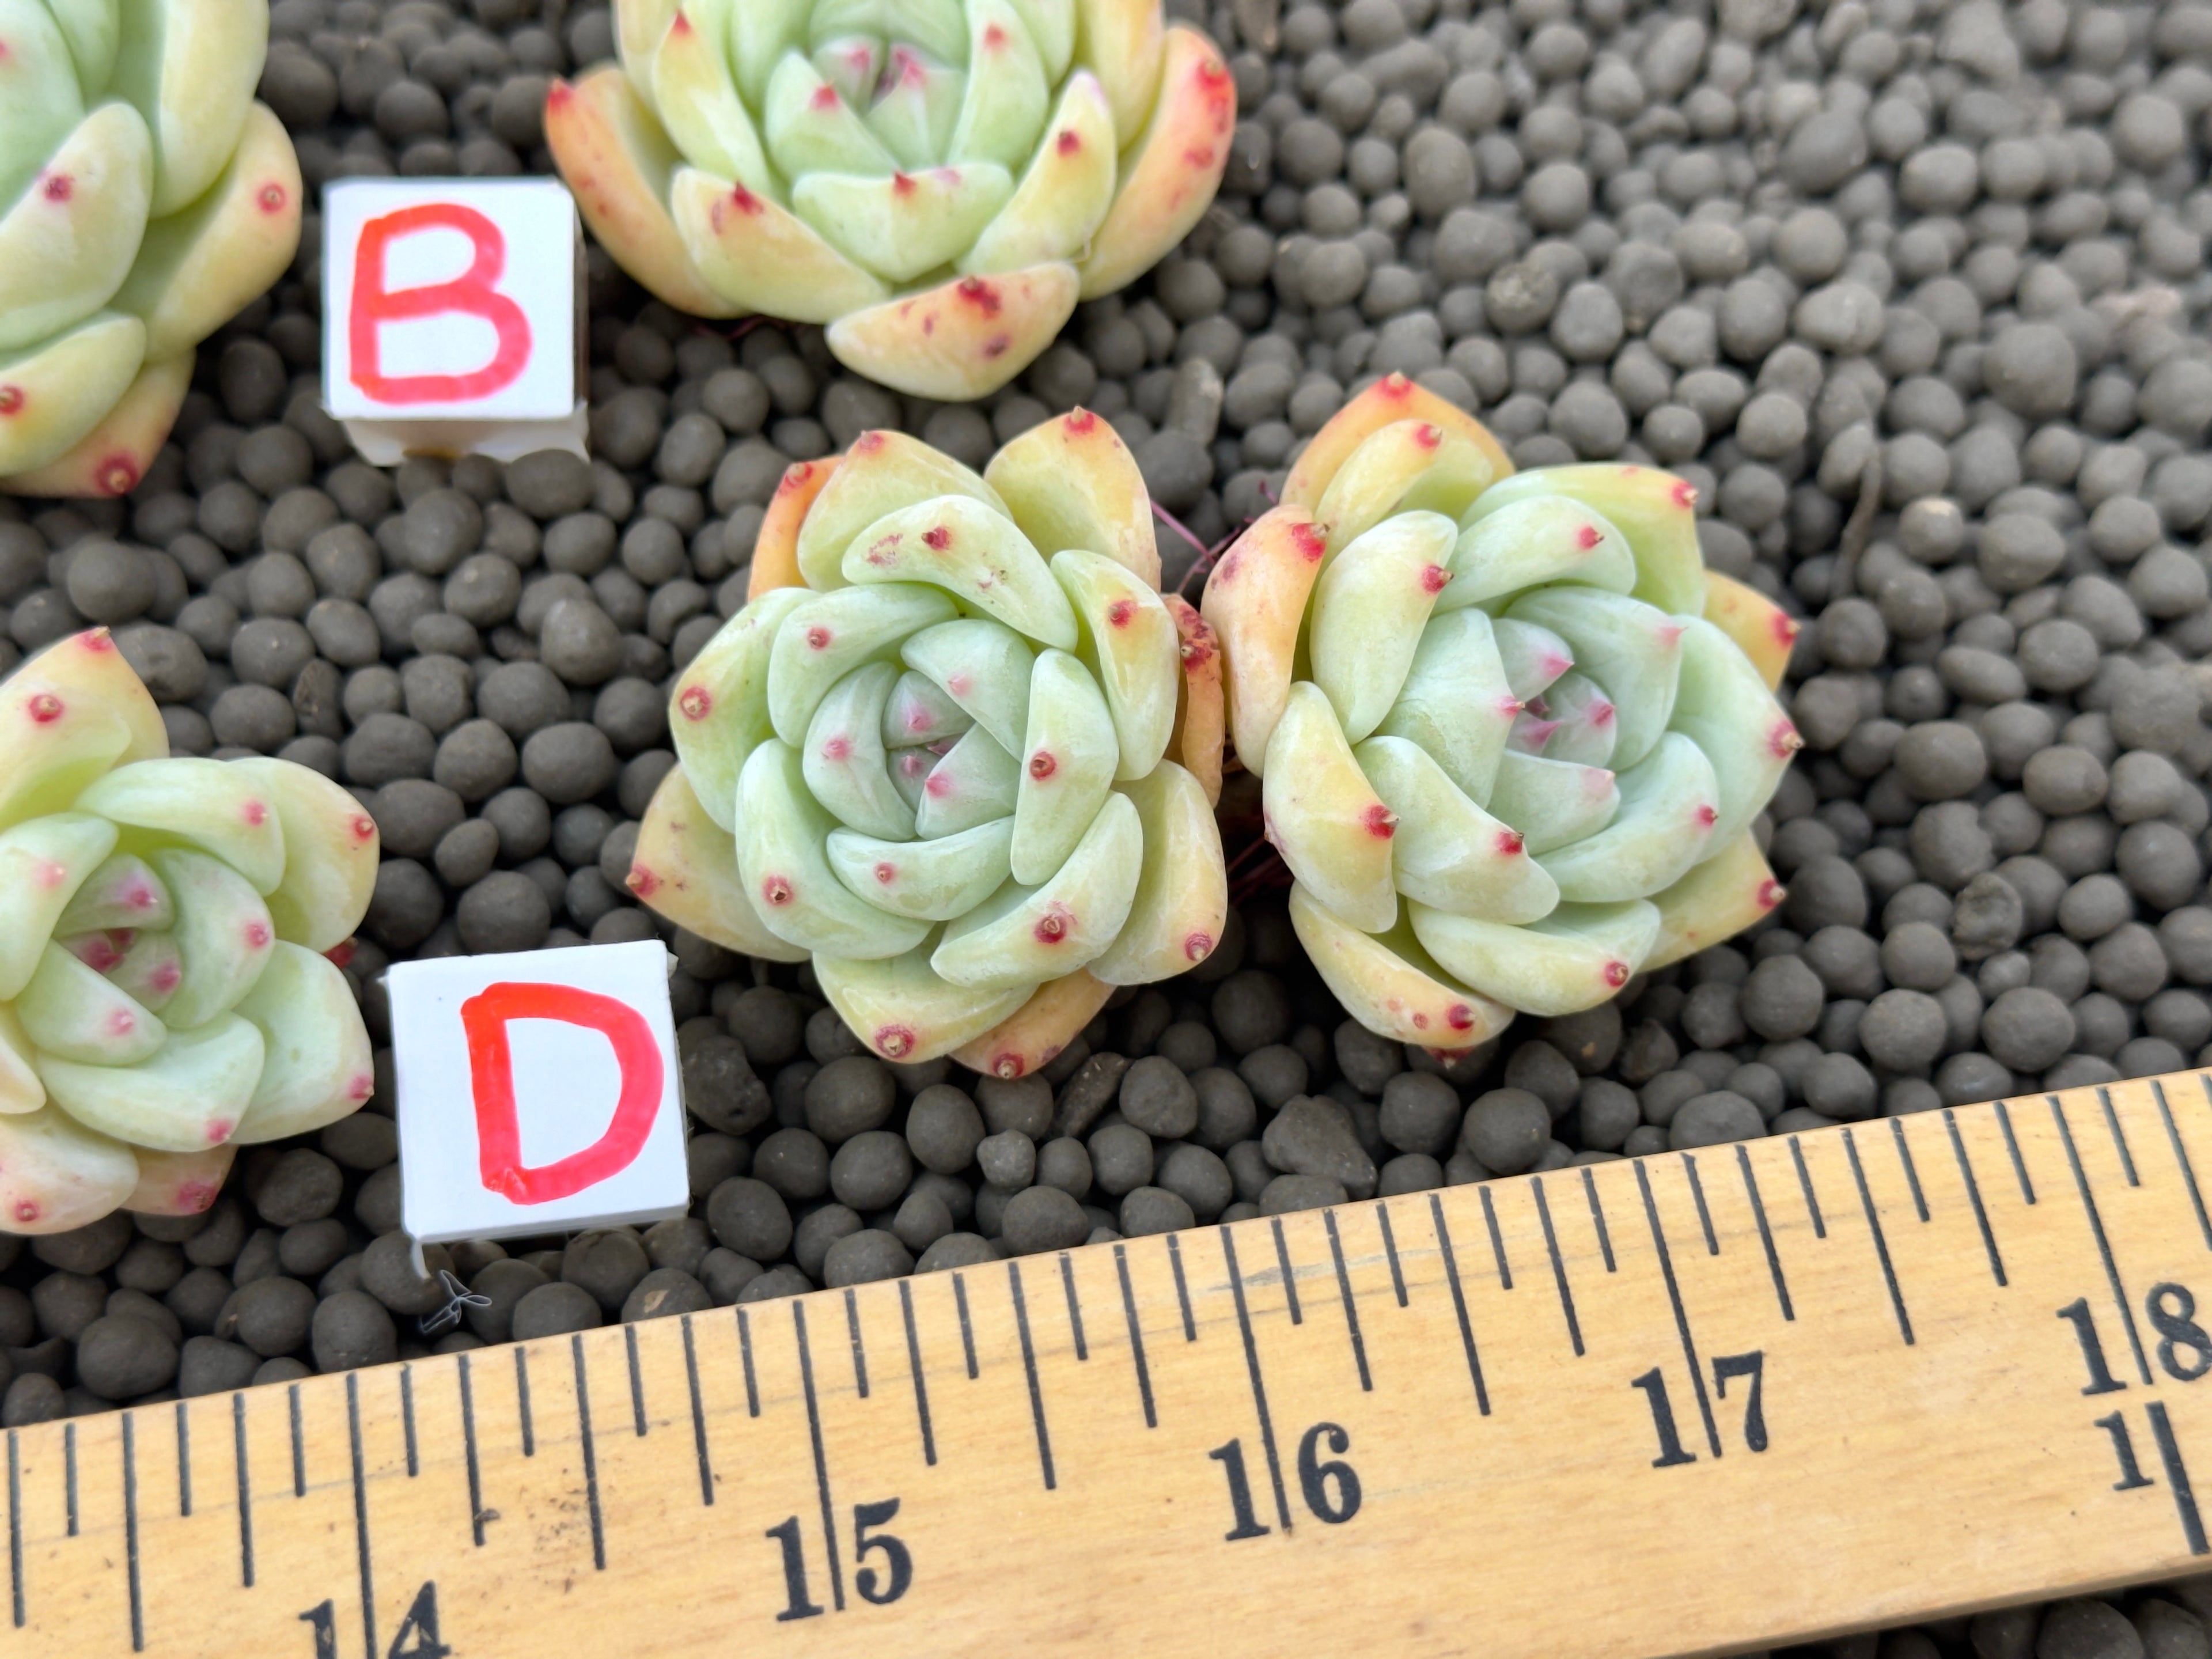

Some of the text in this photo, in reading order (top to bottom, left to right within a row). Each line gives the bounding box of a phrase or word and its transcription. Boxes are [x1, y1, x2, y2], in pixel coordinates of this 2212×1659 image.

[349, 203, 533, 406] B
[461, 982, 664, 1205] D
[2056, 1282, 2212, 1396] 18
[1631, 1350, 1768, 1468] 17
[1209, 1421, 1362, 1541] 16
[765, 1497, 913, 1622] 15
